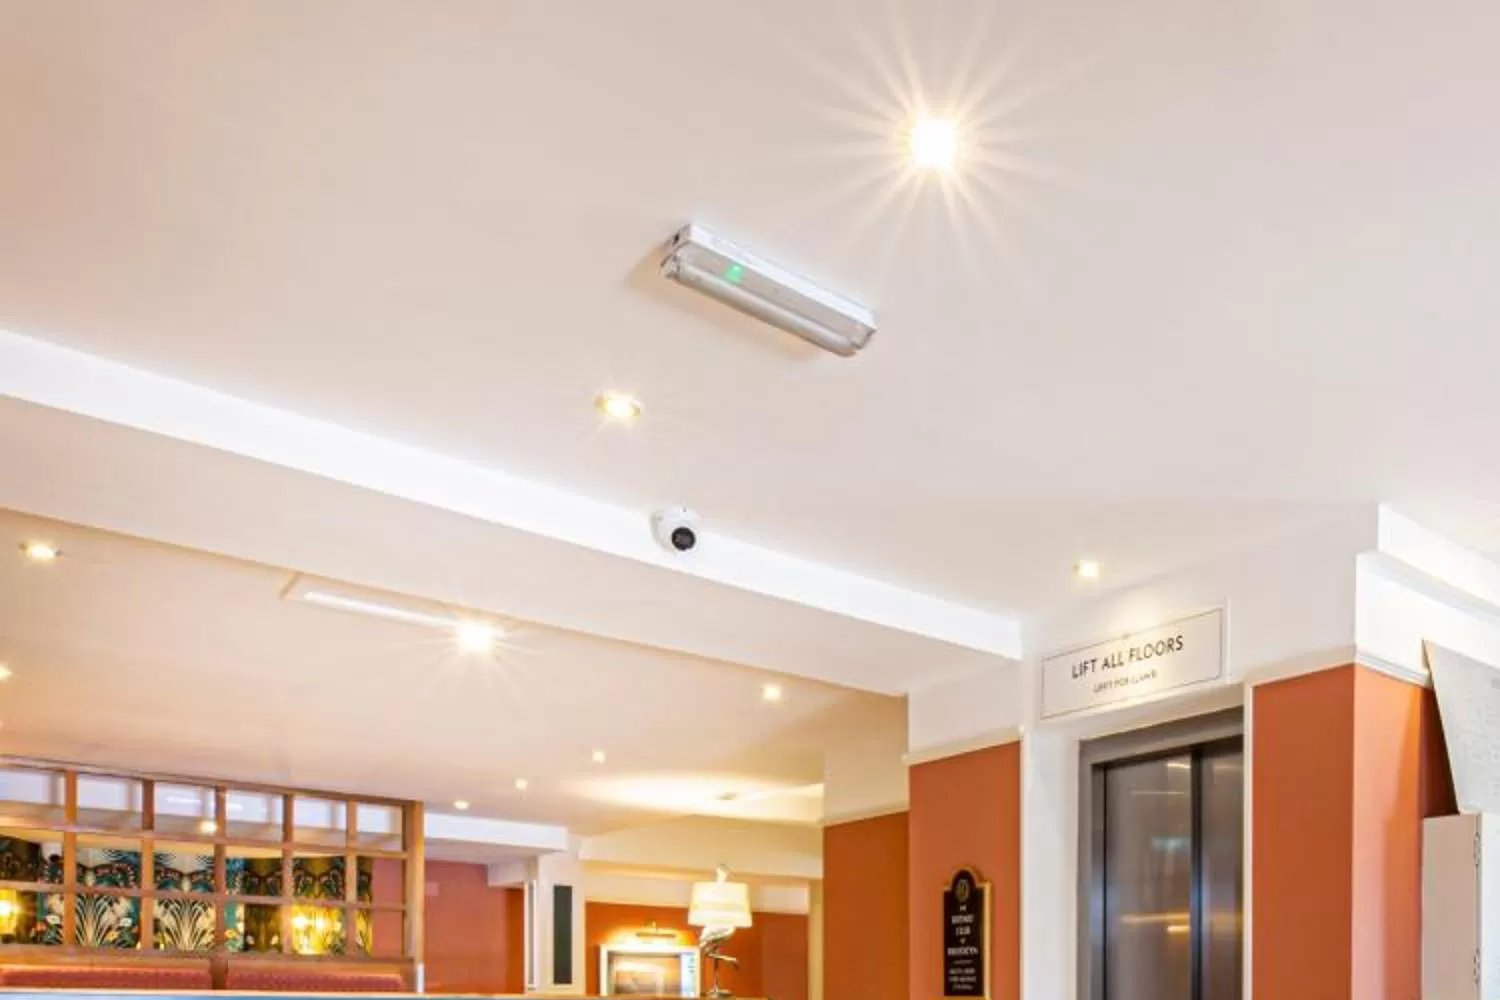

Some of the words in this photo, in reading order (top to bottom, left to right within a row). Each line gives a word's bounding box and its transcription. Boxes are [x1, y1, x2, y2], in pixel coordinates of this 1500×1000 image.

[1072, 658, 1097, 679] LIFT
[1101, 652, 1124, 670] ALL
[1128, 635, 1184, 661] FLOORS
